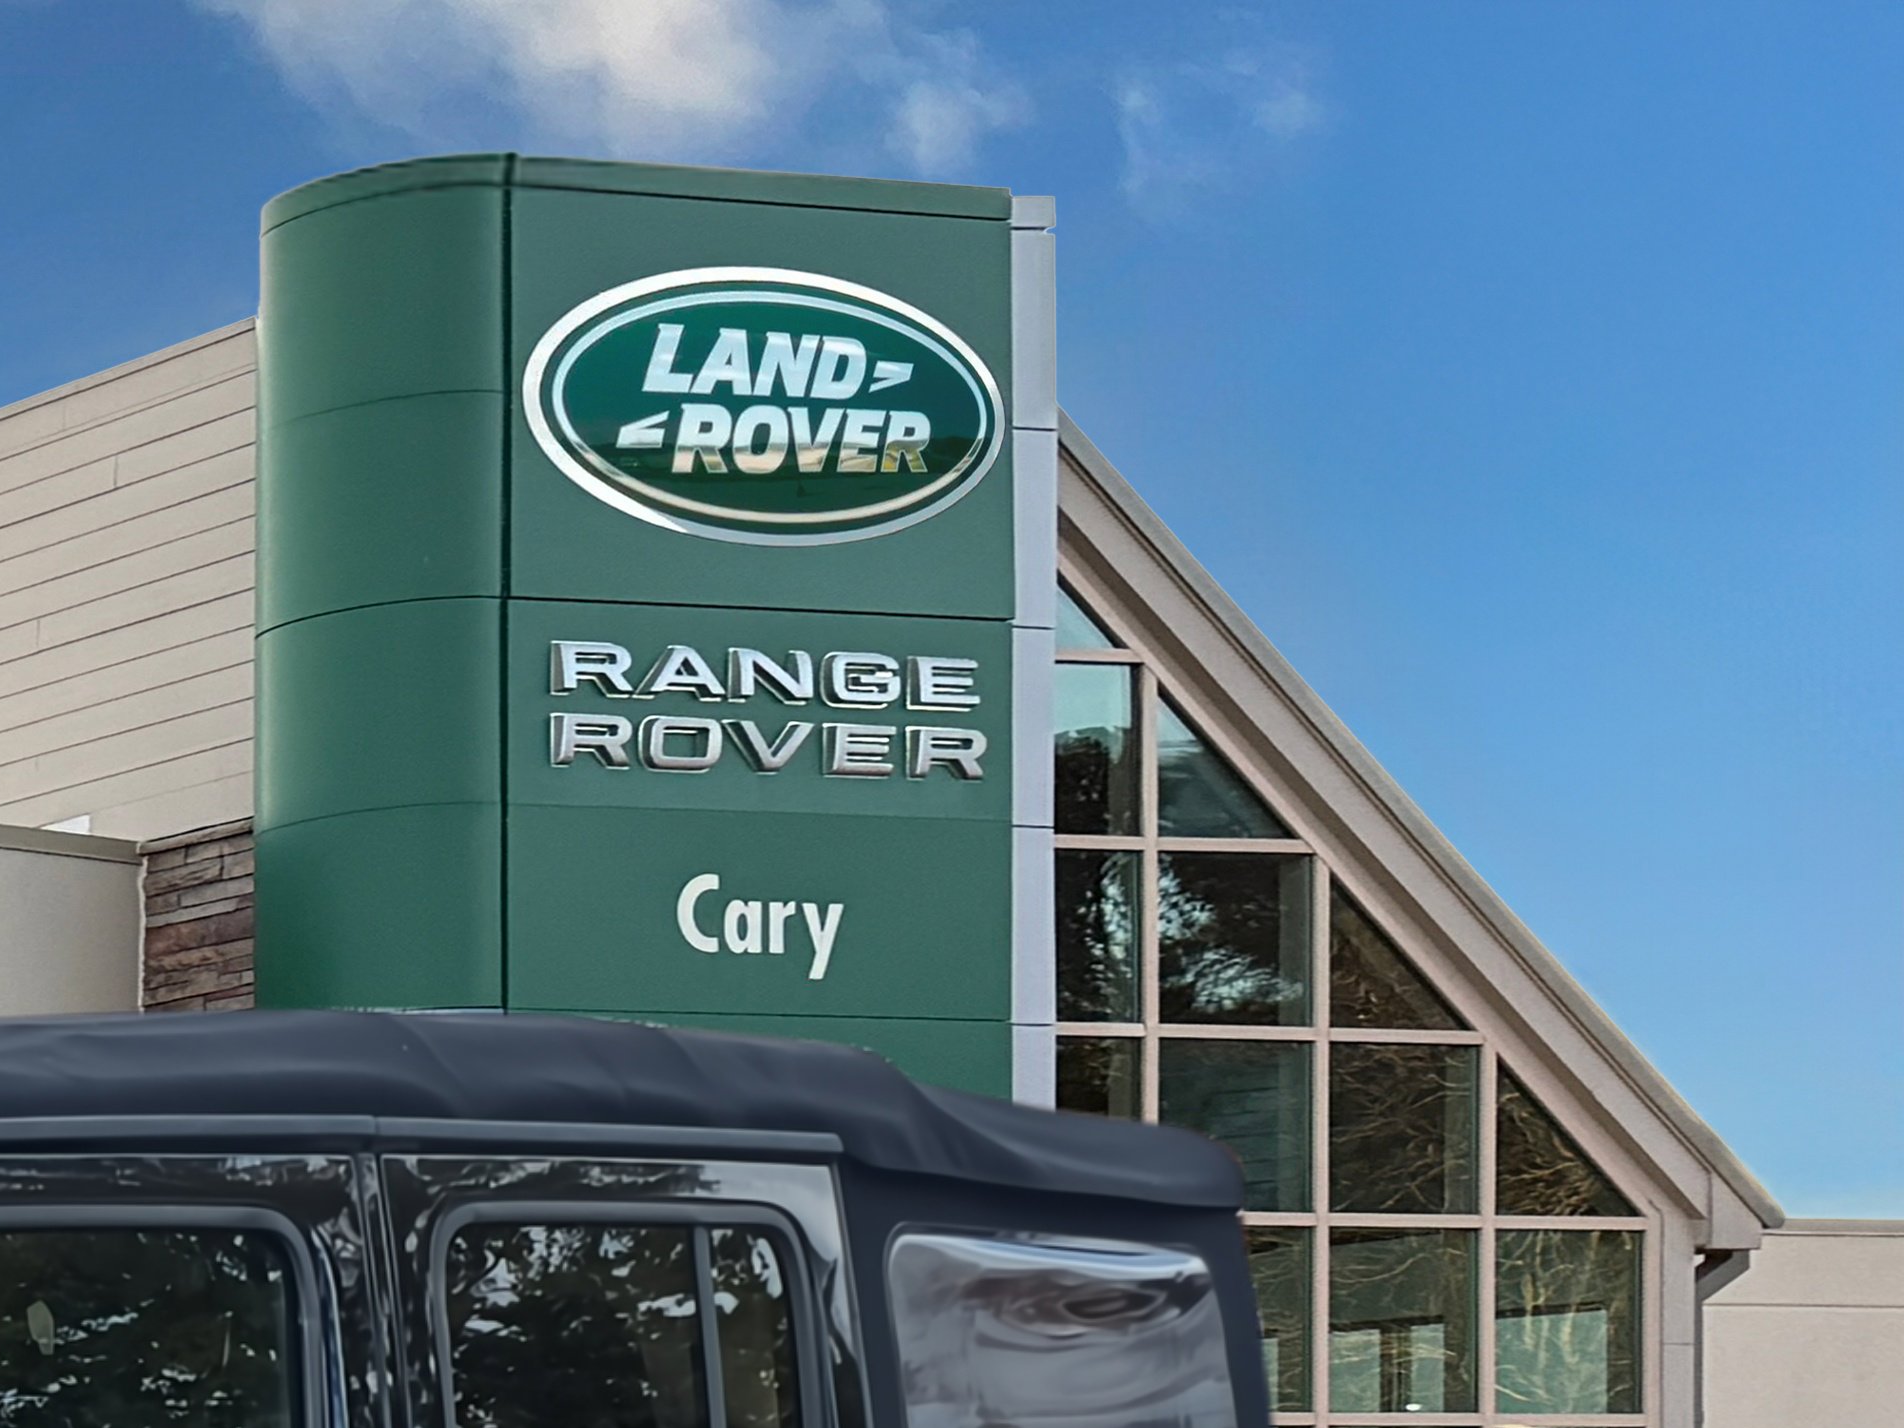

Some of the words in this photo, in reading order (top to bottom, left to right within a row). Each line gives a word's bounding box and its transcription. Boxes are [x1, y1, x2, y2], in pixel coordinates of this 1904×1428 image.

[642, 323, 868, 400] LAND
[670, 403, 932, 475] ROVER
[548, 639, 982, 711] RANGE
[548, 711, 988, 781] ROVER
[676, 873, 846, 981] Cary
